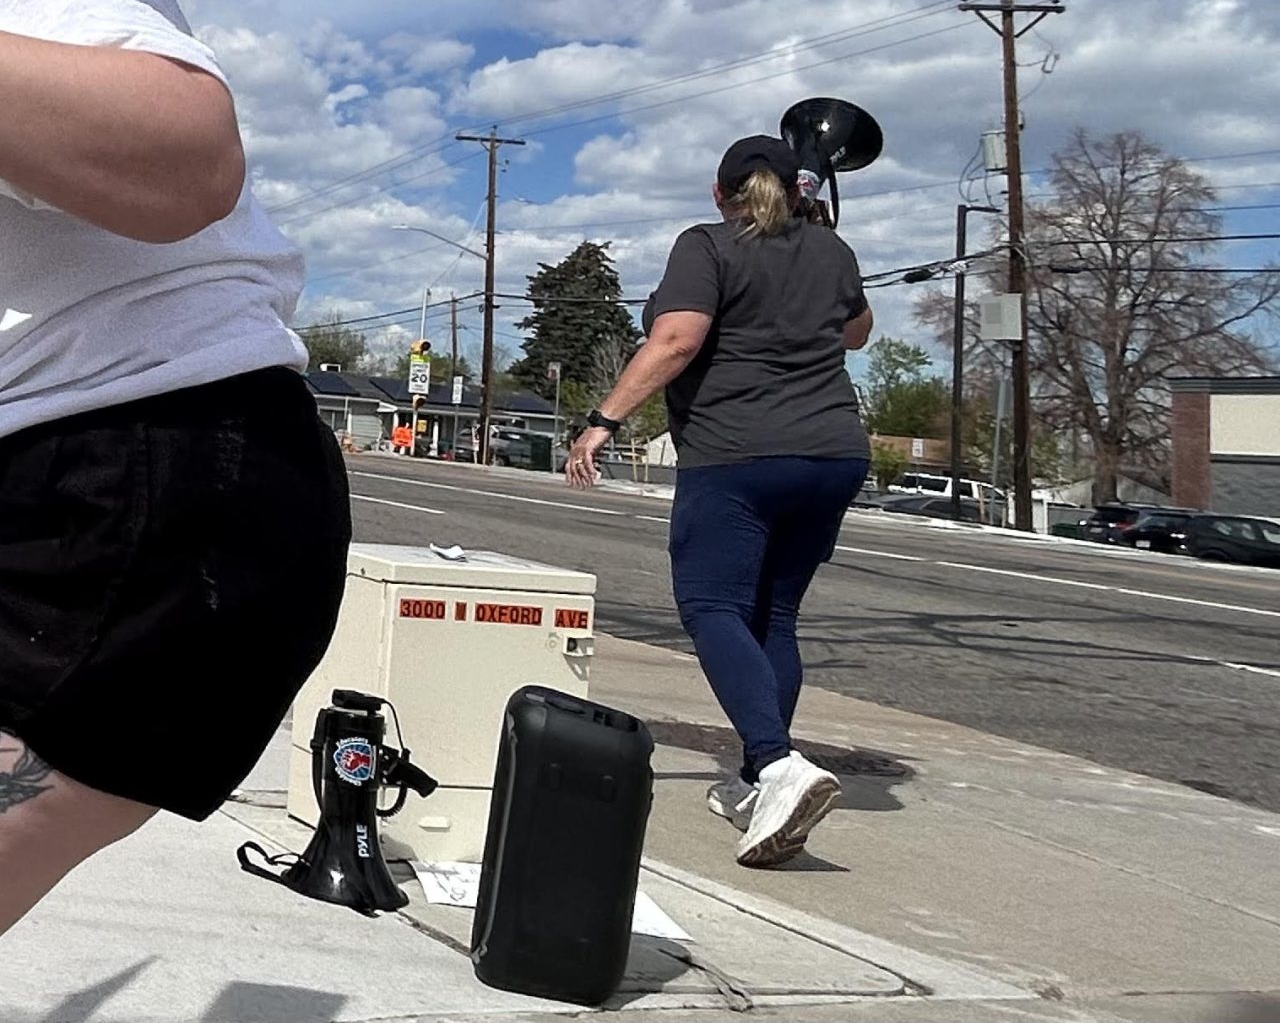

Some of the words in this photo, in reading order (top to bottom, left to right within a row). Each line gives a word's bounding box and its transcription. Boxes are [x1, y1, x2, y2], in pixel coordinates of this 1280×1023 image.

[411, 373, 428, 384] 20
[400, 600, 446, 619] 3000
[475, 604, 543, 626] OXFORD
[555, 609, 589, 629] AVE
[356, 824, 370, 858] PYLE
